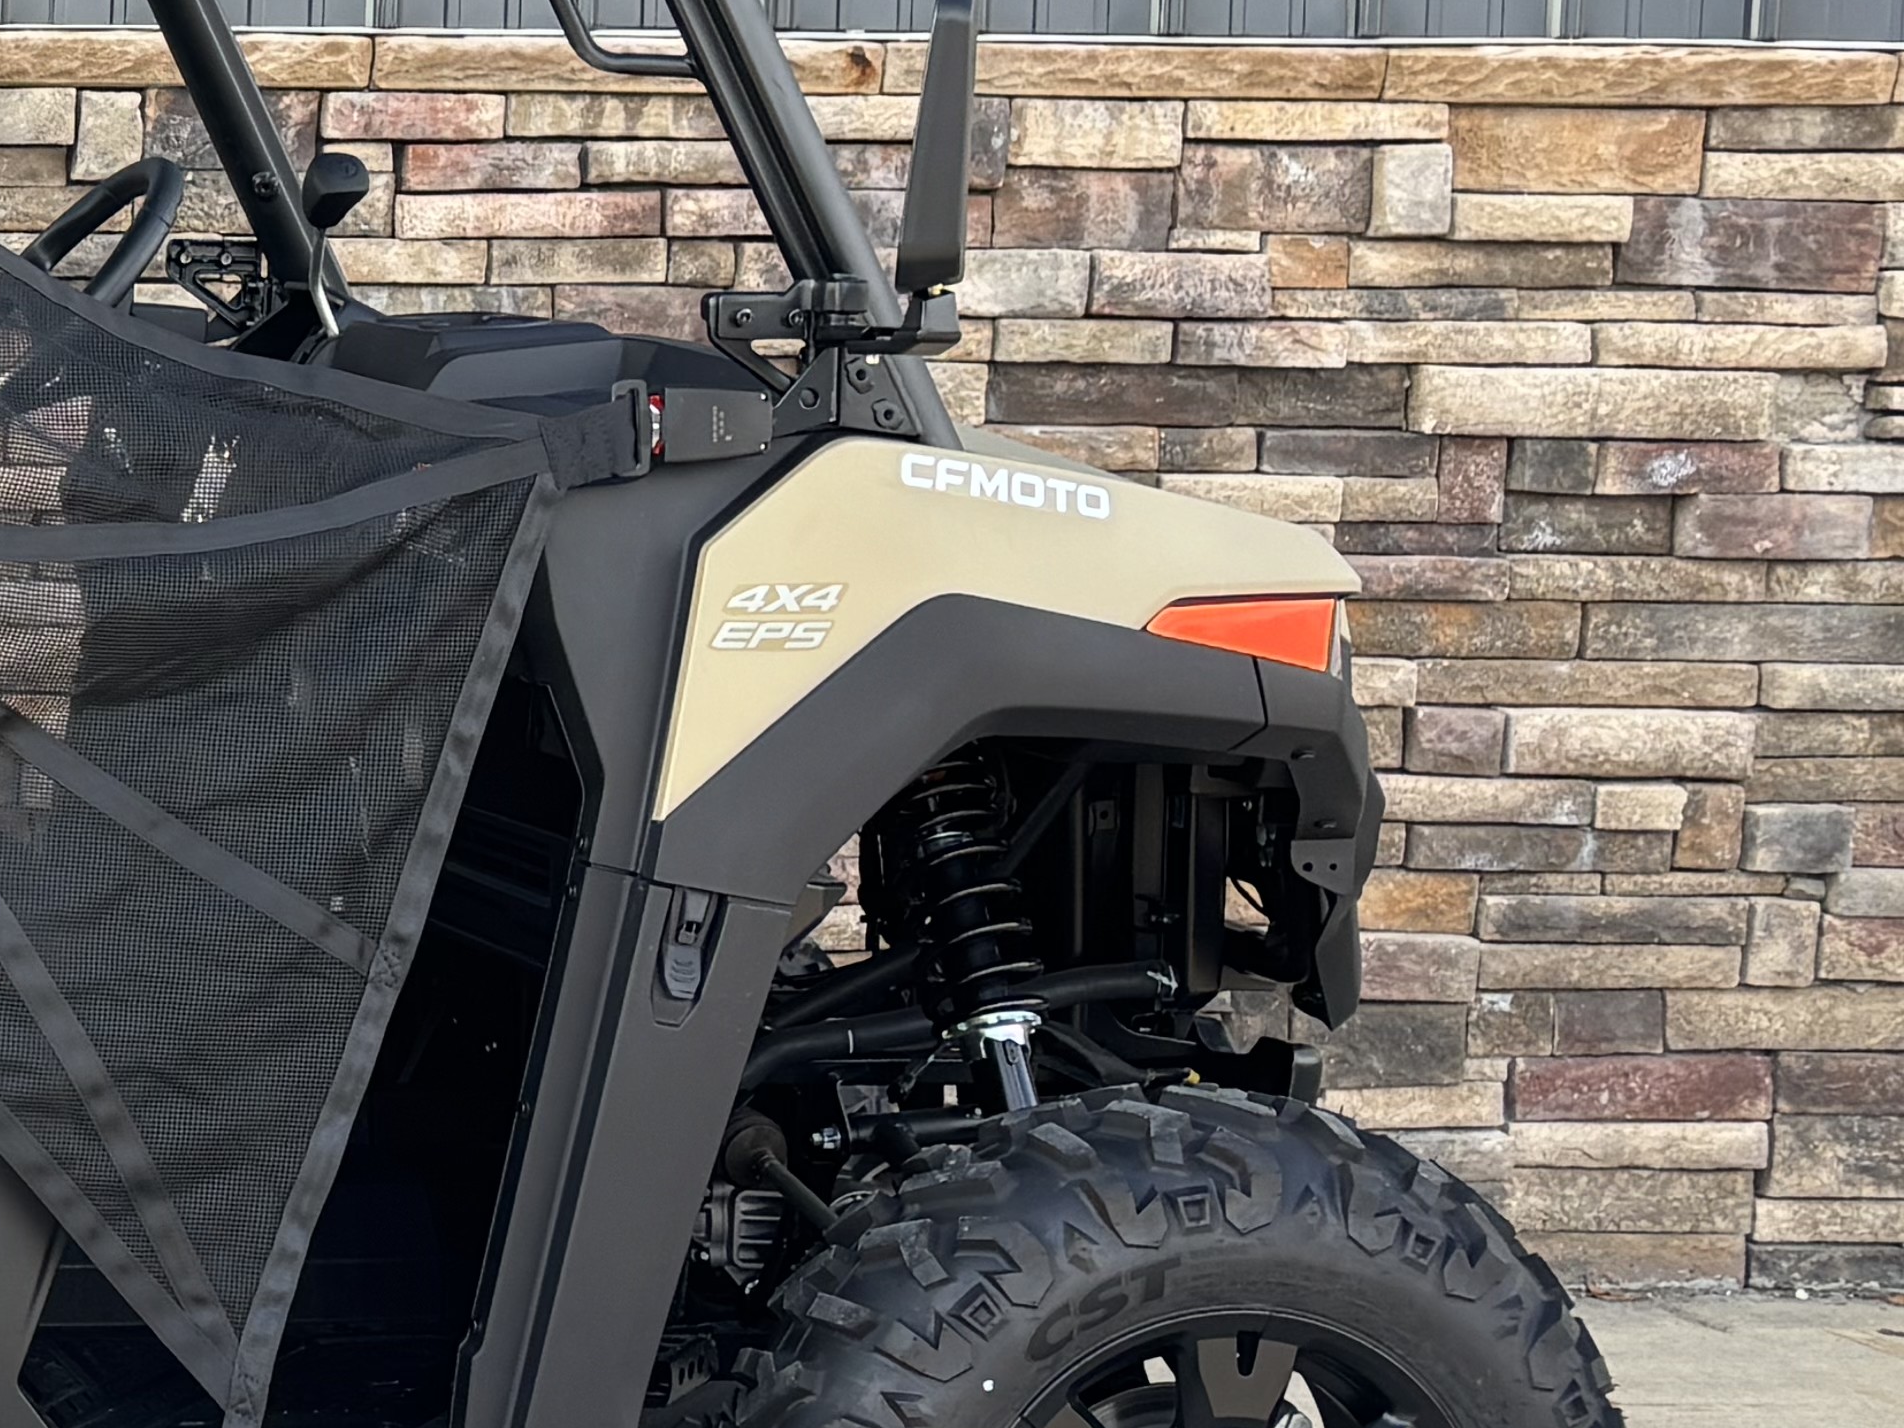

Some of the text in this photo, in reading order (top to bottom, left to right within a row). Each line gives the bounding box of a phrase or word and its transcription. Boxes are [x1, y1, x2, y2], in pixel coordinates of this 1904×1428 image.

[900, 452, 1111, 520] CFMOTO
[726, 584, 843, 612] 4X4
[711, 621, 832, 649] EPS
[1024, 1256, 1183, 1362] CST
